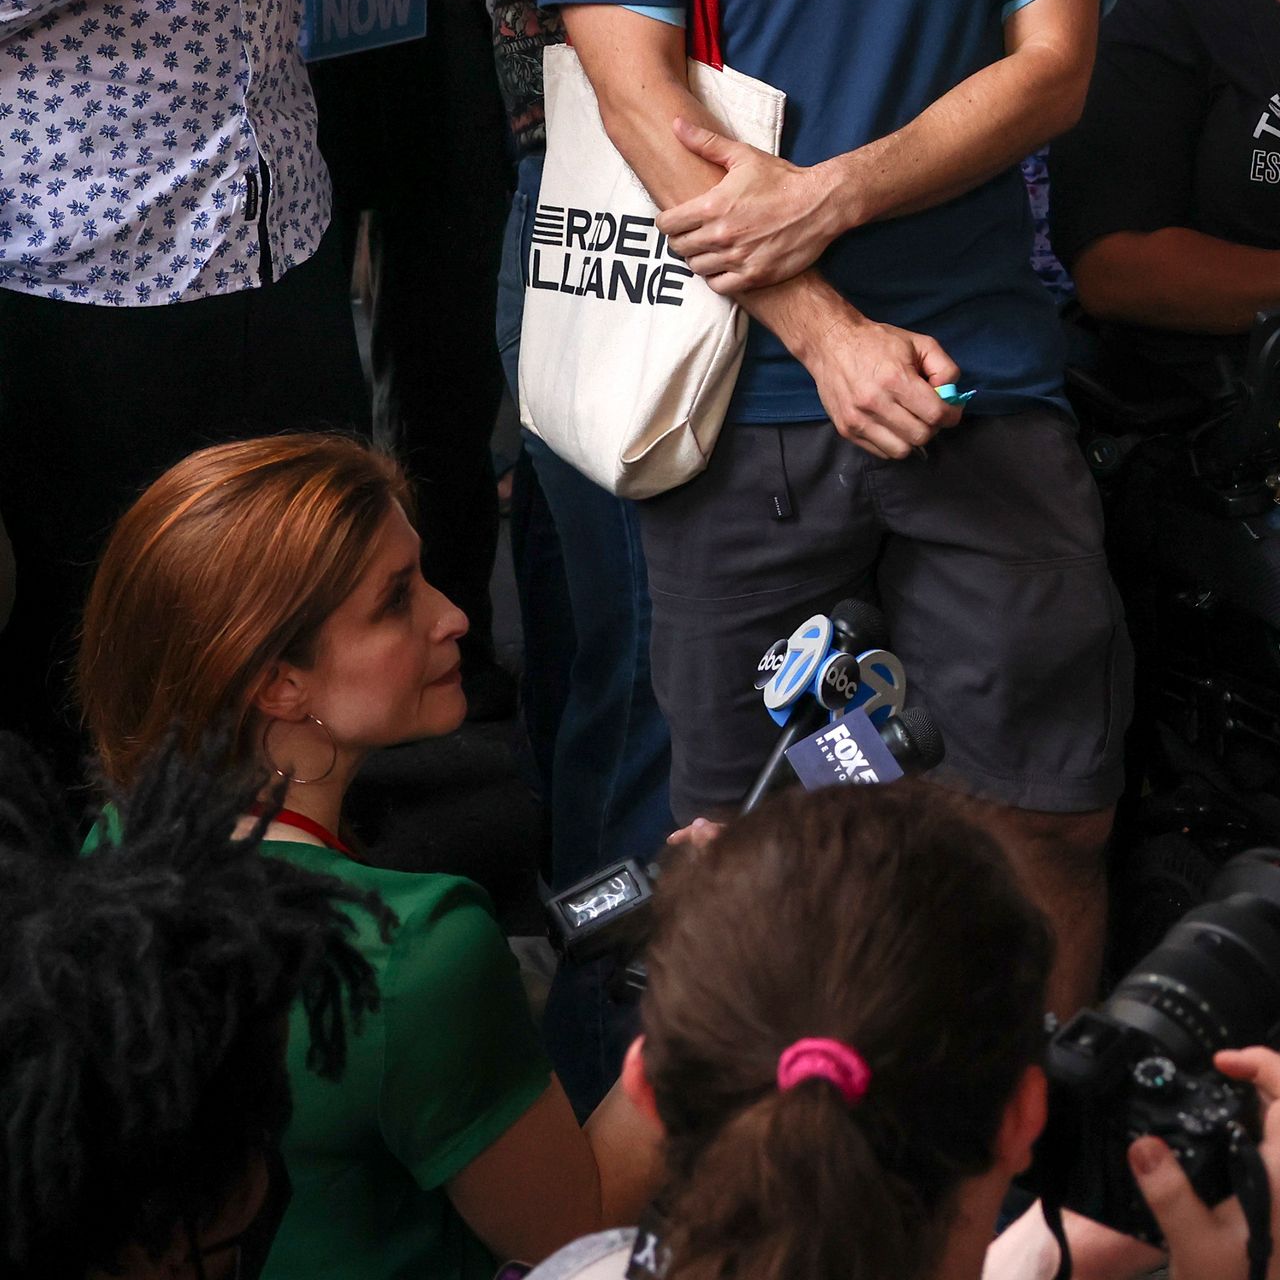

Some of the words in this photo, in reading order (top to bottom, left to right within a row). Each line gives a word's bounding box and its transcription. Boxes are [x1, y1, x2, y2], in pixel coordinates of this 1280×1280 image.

[758, 651, 783, 671] abc
[825, 667, 857, 699] abc
[815, 736, 835, 762] NEW
[824, 723, 869, 777] FOX
